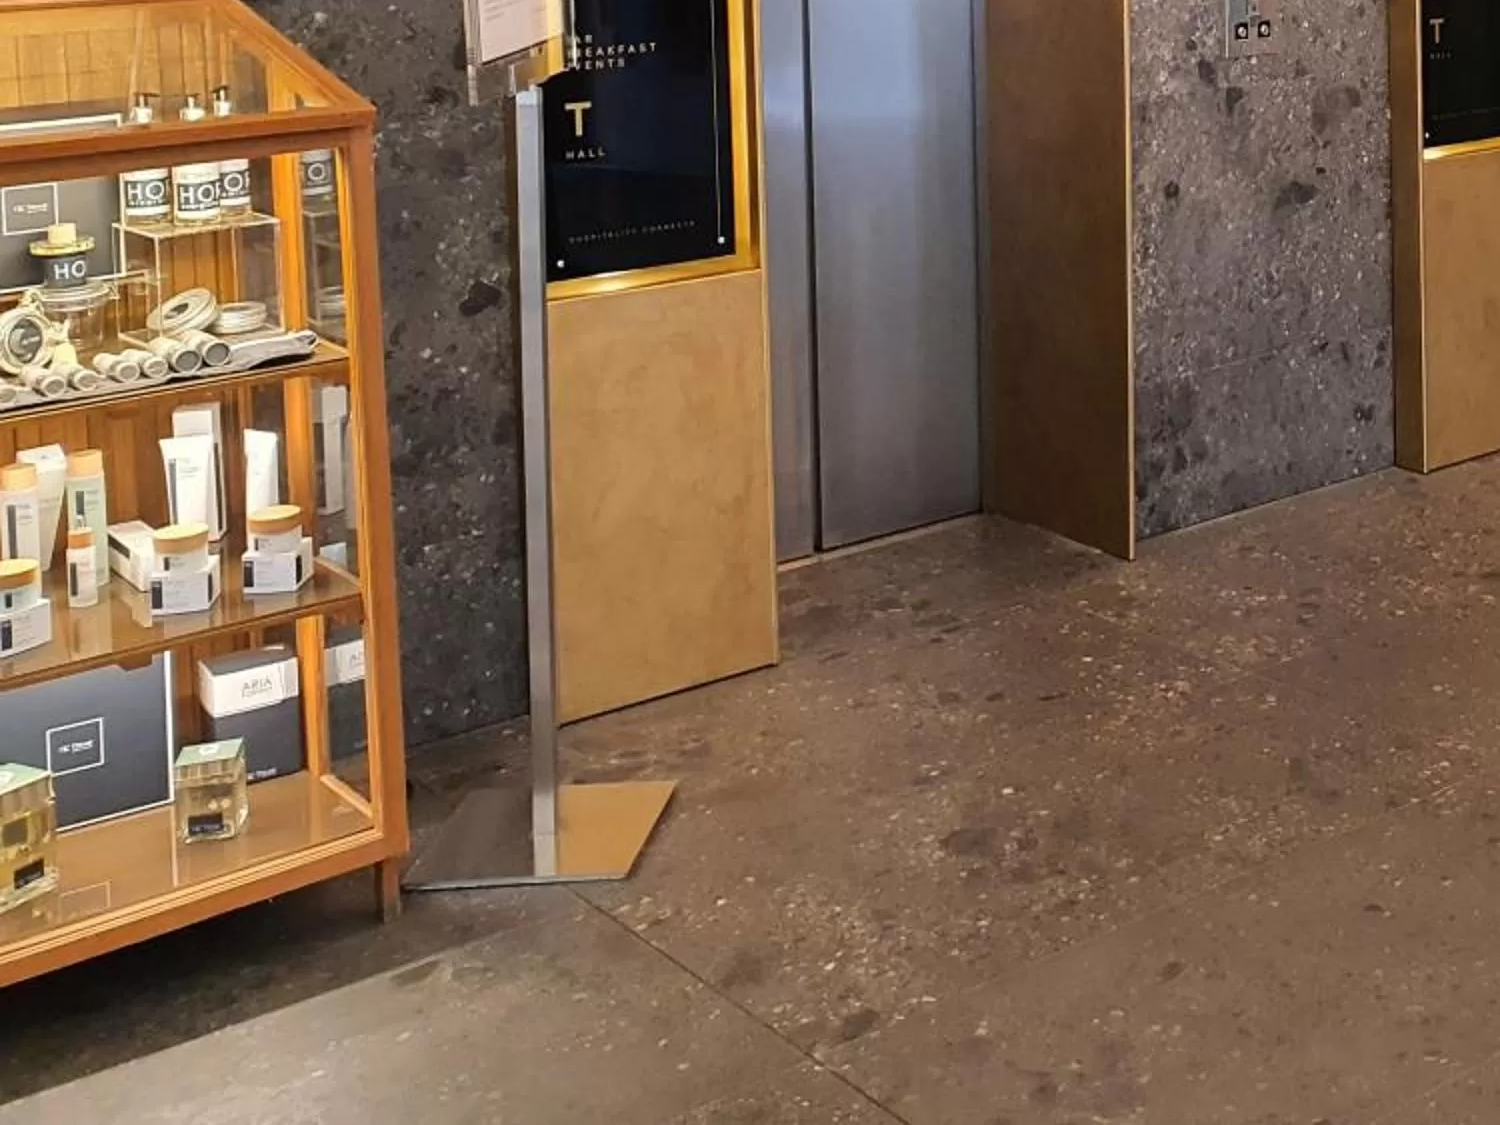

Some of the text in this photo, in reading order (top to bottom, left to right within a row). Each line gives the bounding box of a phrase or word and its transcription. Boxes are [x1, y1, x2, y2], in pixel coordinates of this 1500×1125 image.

[1429, 17, 1445, 45] T
[564, 100, 593, 137] T
[565, 146, 607, 160] HALL
